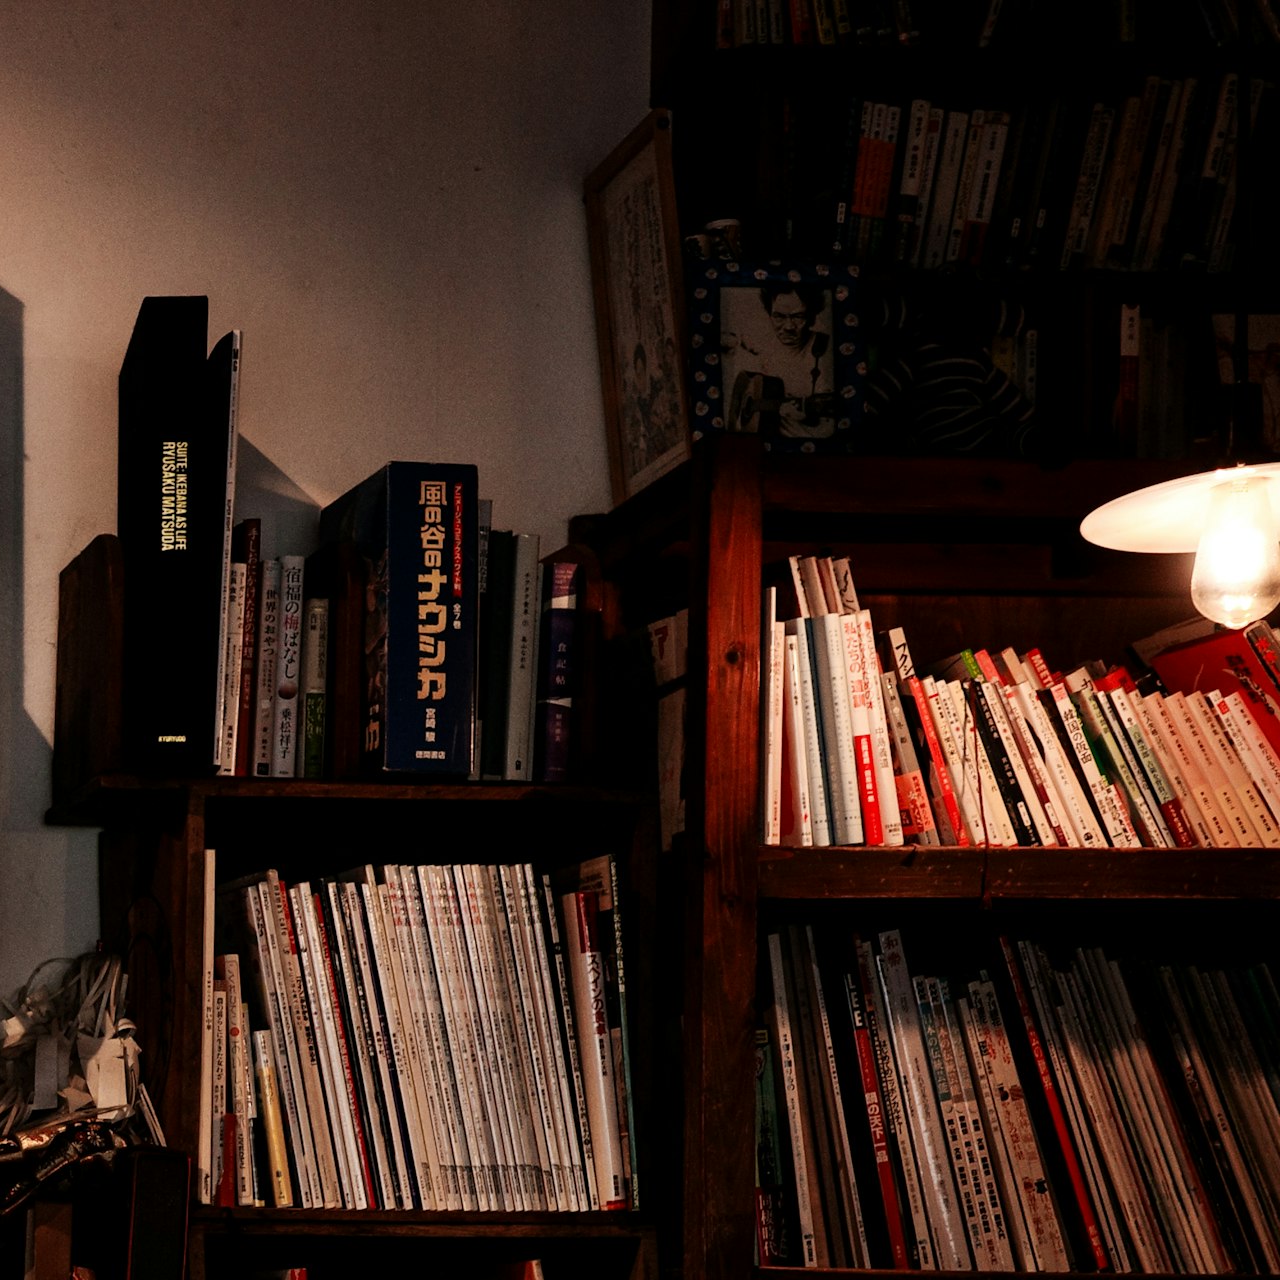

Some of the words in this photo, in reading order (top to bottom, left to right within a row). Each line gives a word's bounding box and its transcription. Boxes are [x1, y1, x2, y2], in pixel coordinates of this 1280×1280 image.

[162, 441, 176, 494] RYUSAKU
[176, 441, 188, 472] SUITE:
[176, 473, 188, 514] IKEBANA
[161, 496, 175, 551] MATSUDA
[175, 530, 187, 550] LIFE
[176, 516, 187, 528] AS
[416, 480, 449, 701] 風の谷のナウシカ
[265, 589, 277, 657] 世界のおやつ
[283, 565, 302, 680] 宿福の梅ばなし
[452, 603, 462, 630] 全7巻
[555, 641, 568, 686] 食記帖
[279, 709, 293, 761] 乗松祥子
[425, 707, 437, 743] 宮崎駿
[414, 750, 447, 761] 徳間書店
[847, 974, 863, 1027] LEE
